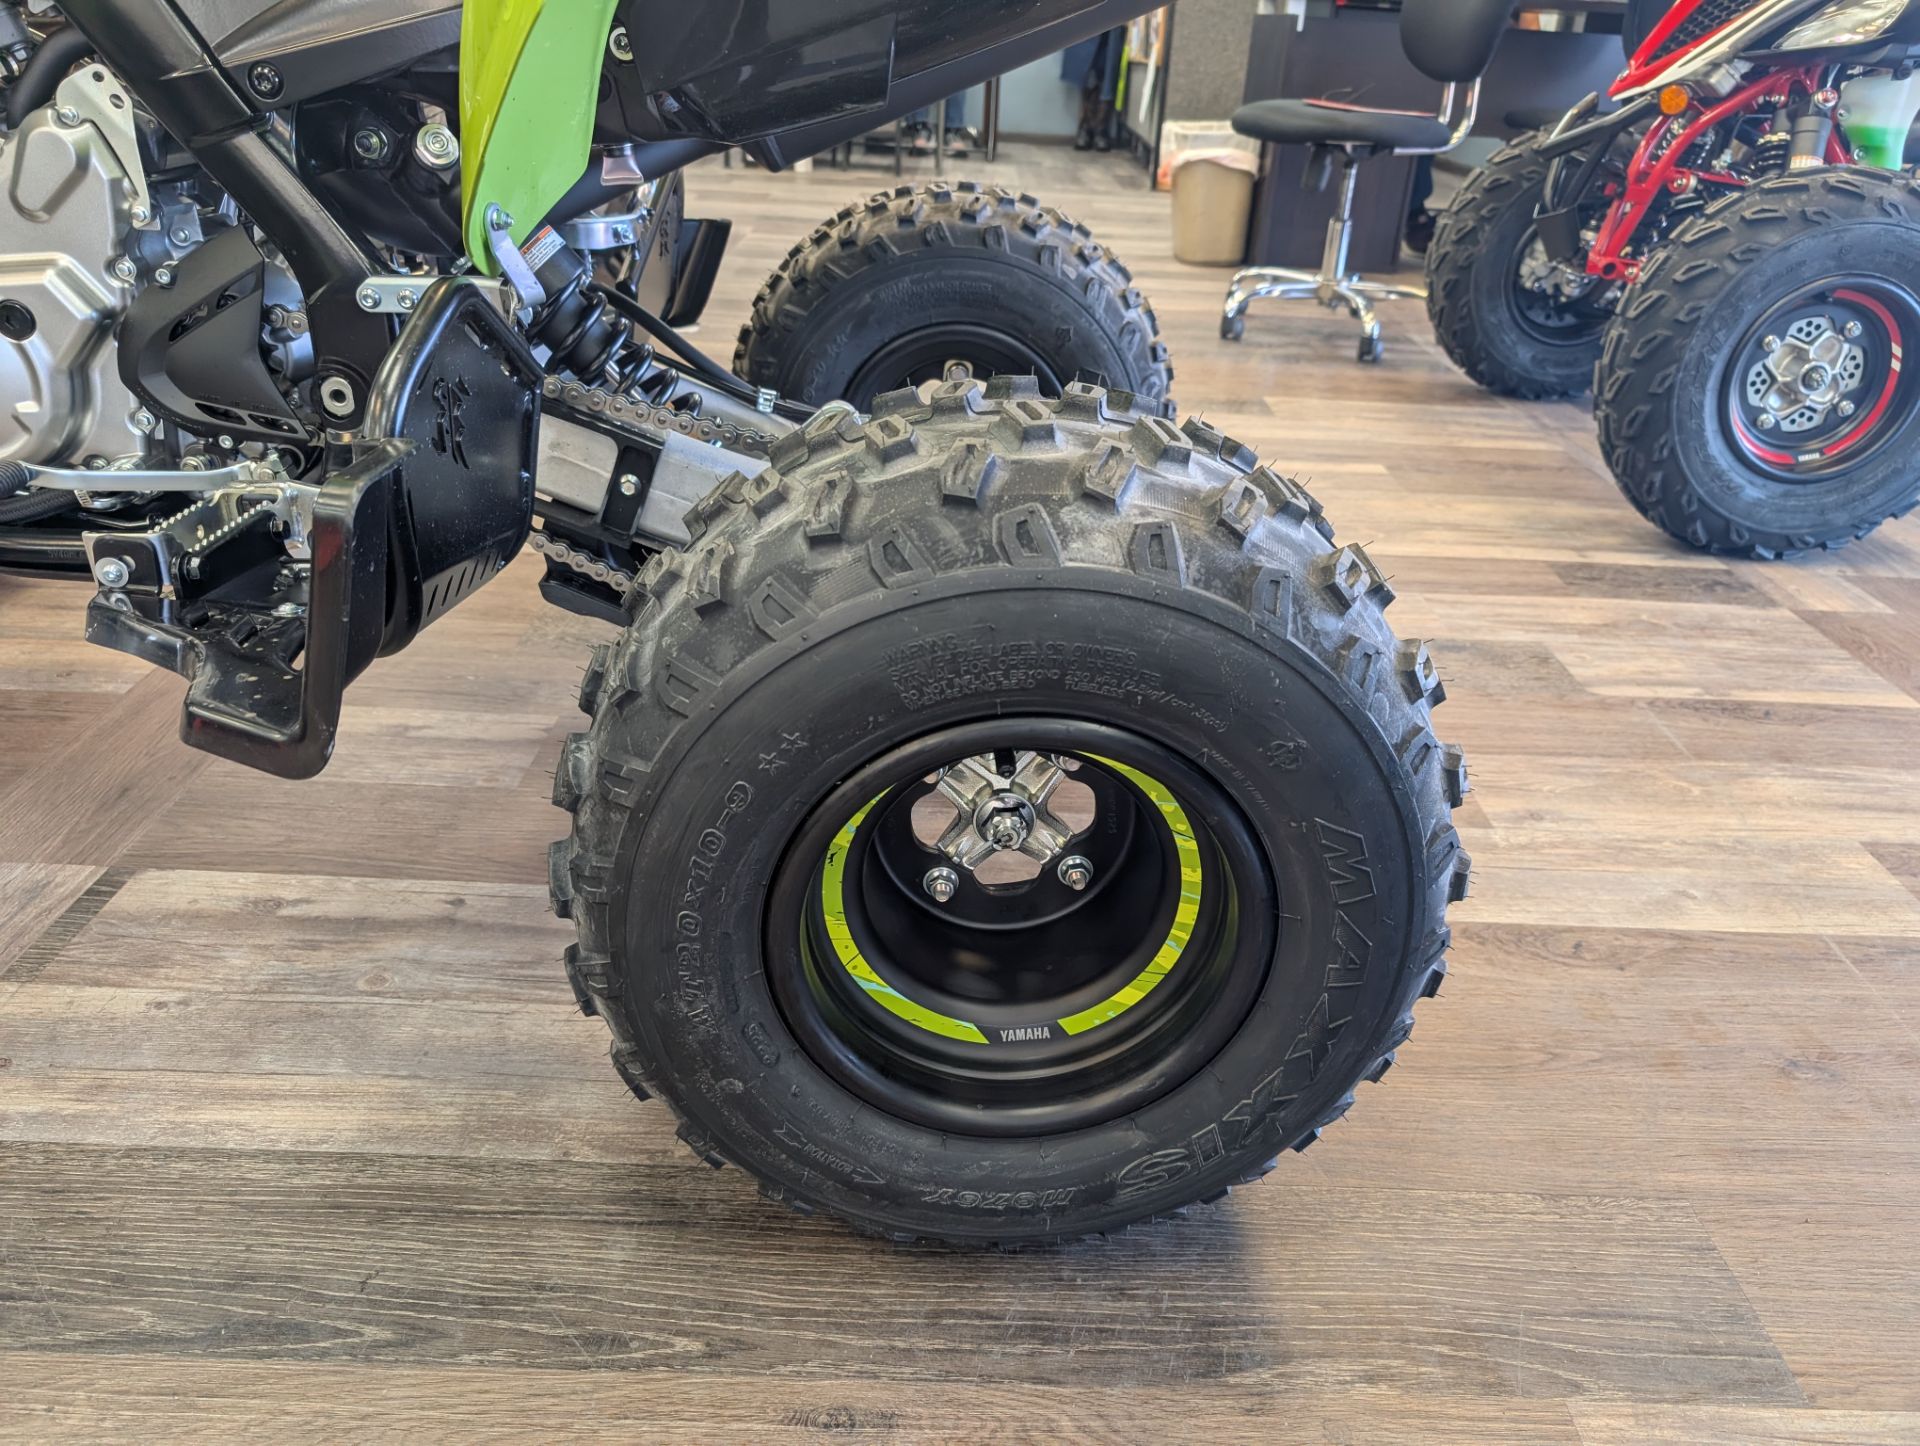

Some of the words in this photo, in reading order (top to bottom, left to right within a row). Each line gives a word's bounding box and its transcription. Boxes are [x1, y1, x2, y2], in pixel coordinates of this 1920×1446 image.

[961, 659, 990, 675] FOR
[923, 680, 948, 697] NOT
[1010, 669, 1061, 680] BEYOND
[1064, 680, 1126, 698] TUBELESS
[1117, 817, 1377, 1195] MAXXIS
[1000, 1026, 1051, 1042] YAMAHA
[803, 1143, 854, 1174] ROTATION
[921, 1187, 1078, 1210] M976Y
